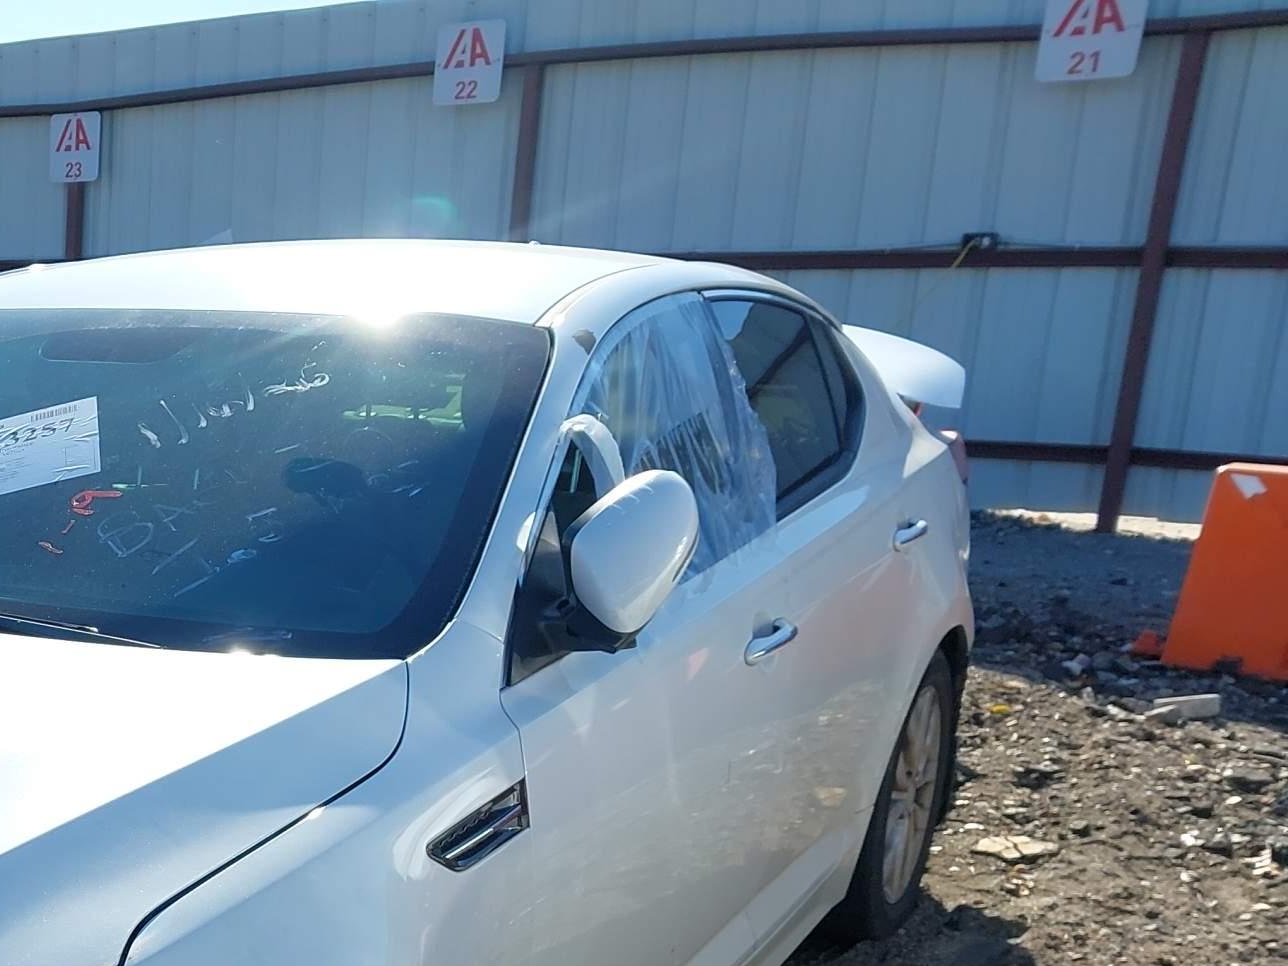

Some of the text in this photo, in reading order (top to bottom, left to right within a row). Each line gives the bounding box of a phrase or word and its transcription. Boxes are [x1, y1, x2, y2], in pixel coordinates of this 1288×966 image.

[1066, 49, 1101, 75] 21
[454, 80, 478, 100] 22
[65, 161, 82, 178] 23
